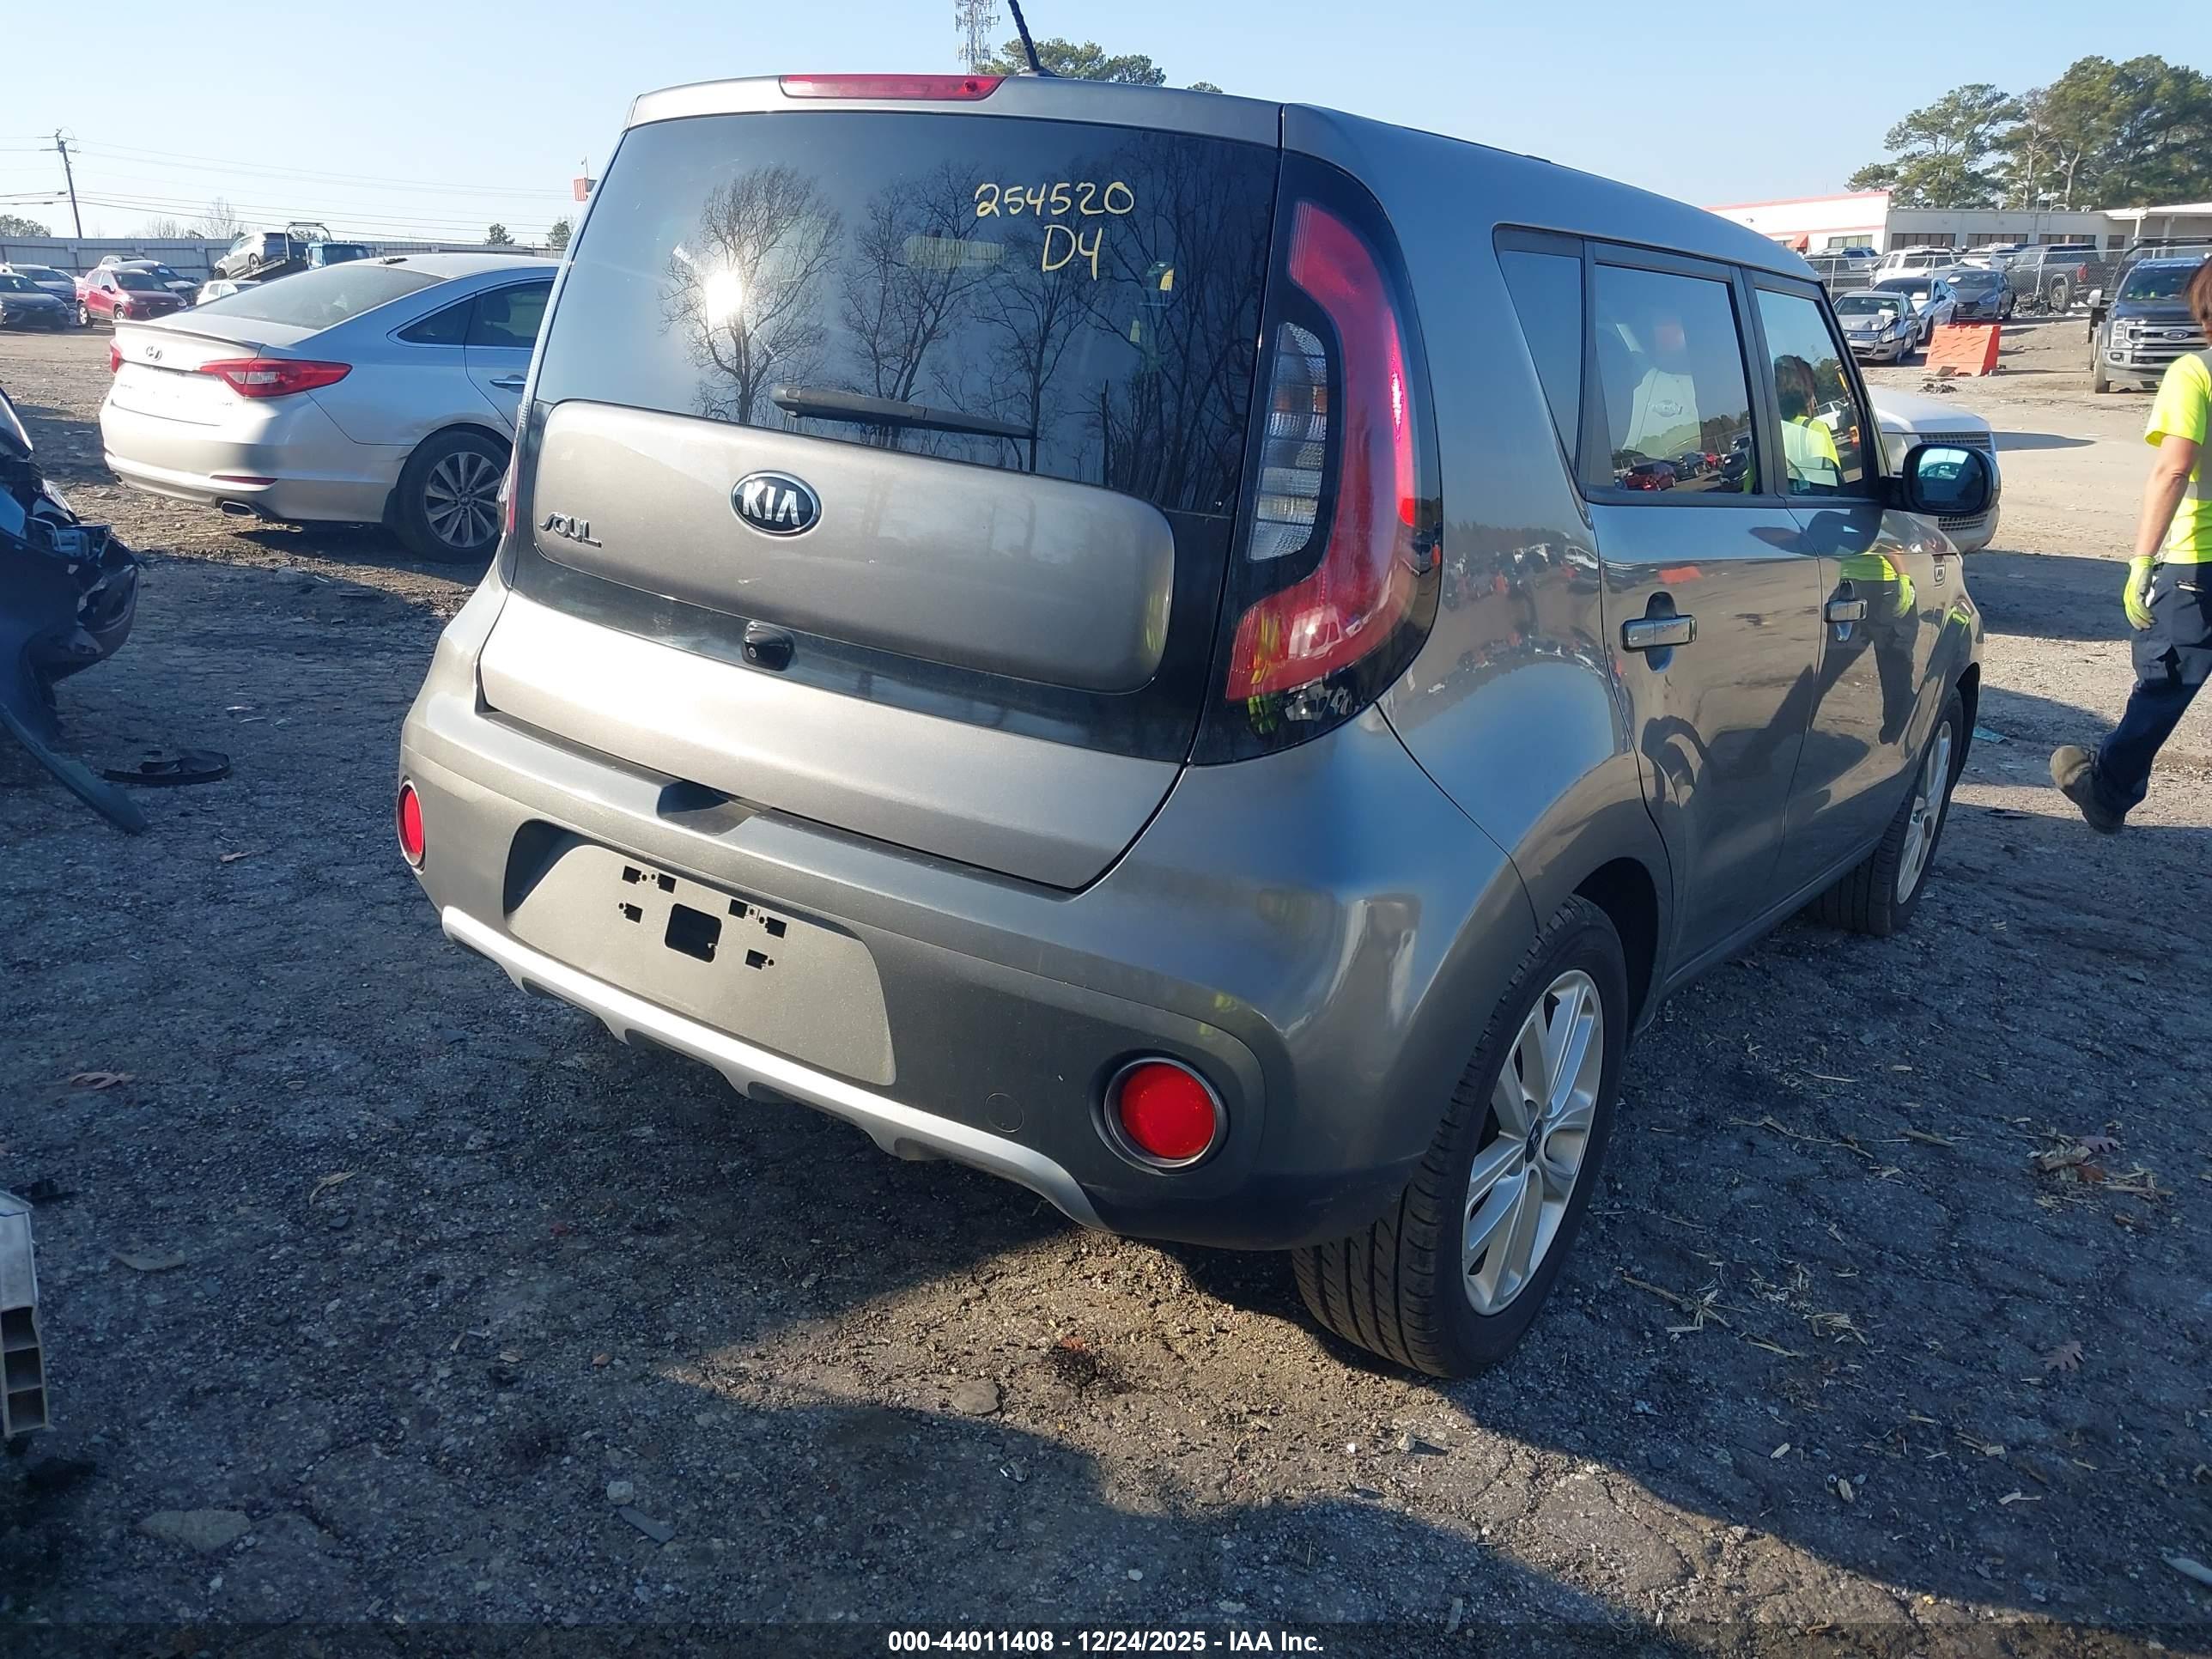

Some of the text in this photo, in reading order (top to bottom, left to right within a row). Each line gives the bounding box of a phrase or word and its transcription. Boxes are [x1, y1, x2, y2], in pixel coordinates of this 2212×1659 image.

[974, 181, 1135, 218] 254520
[1041, 224, 1103, 282] D4
[742, 481, 801, 526] KIA
[538, 511, 603, 549] SOUL
